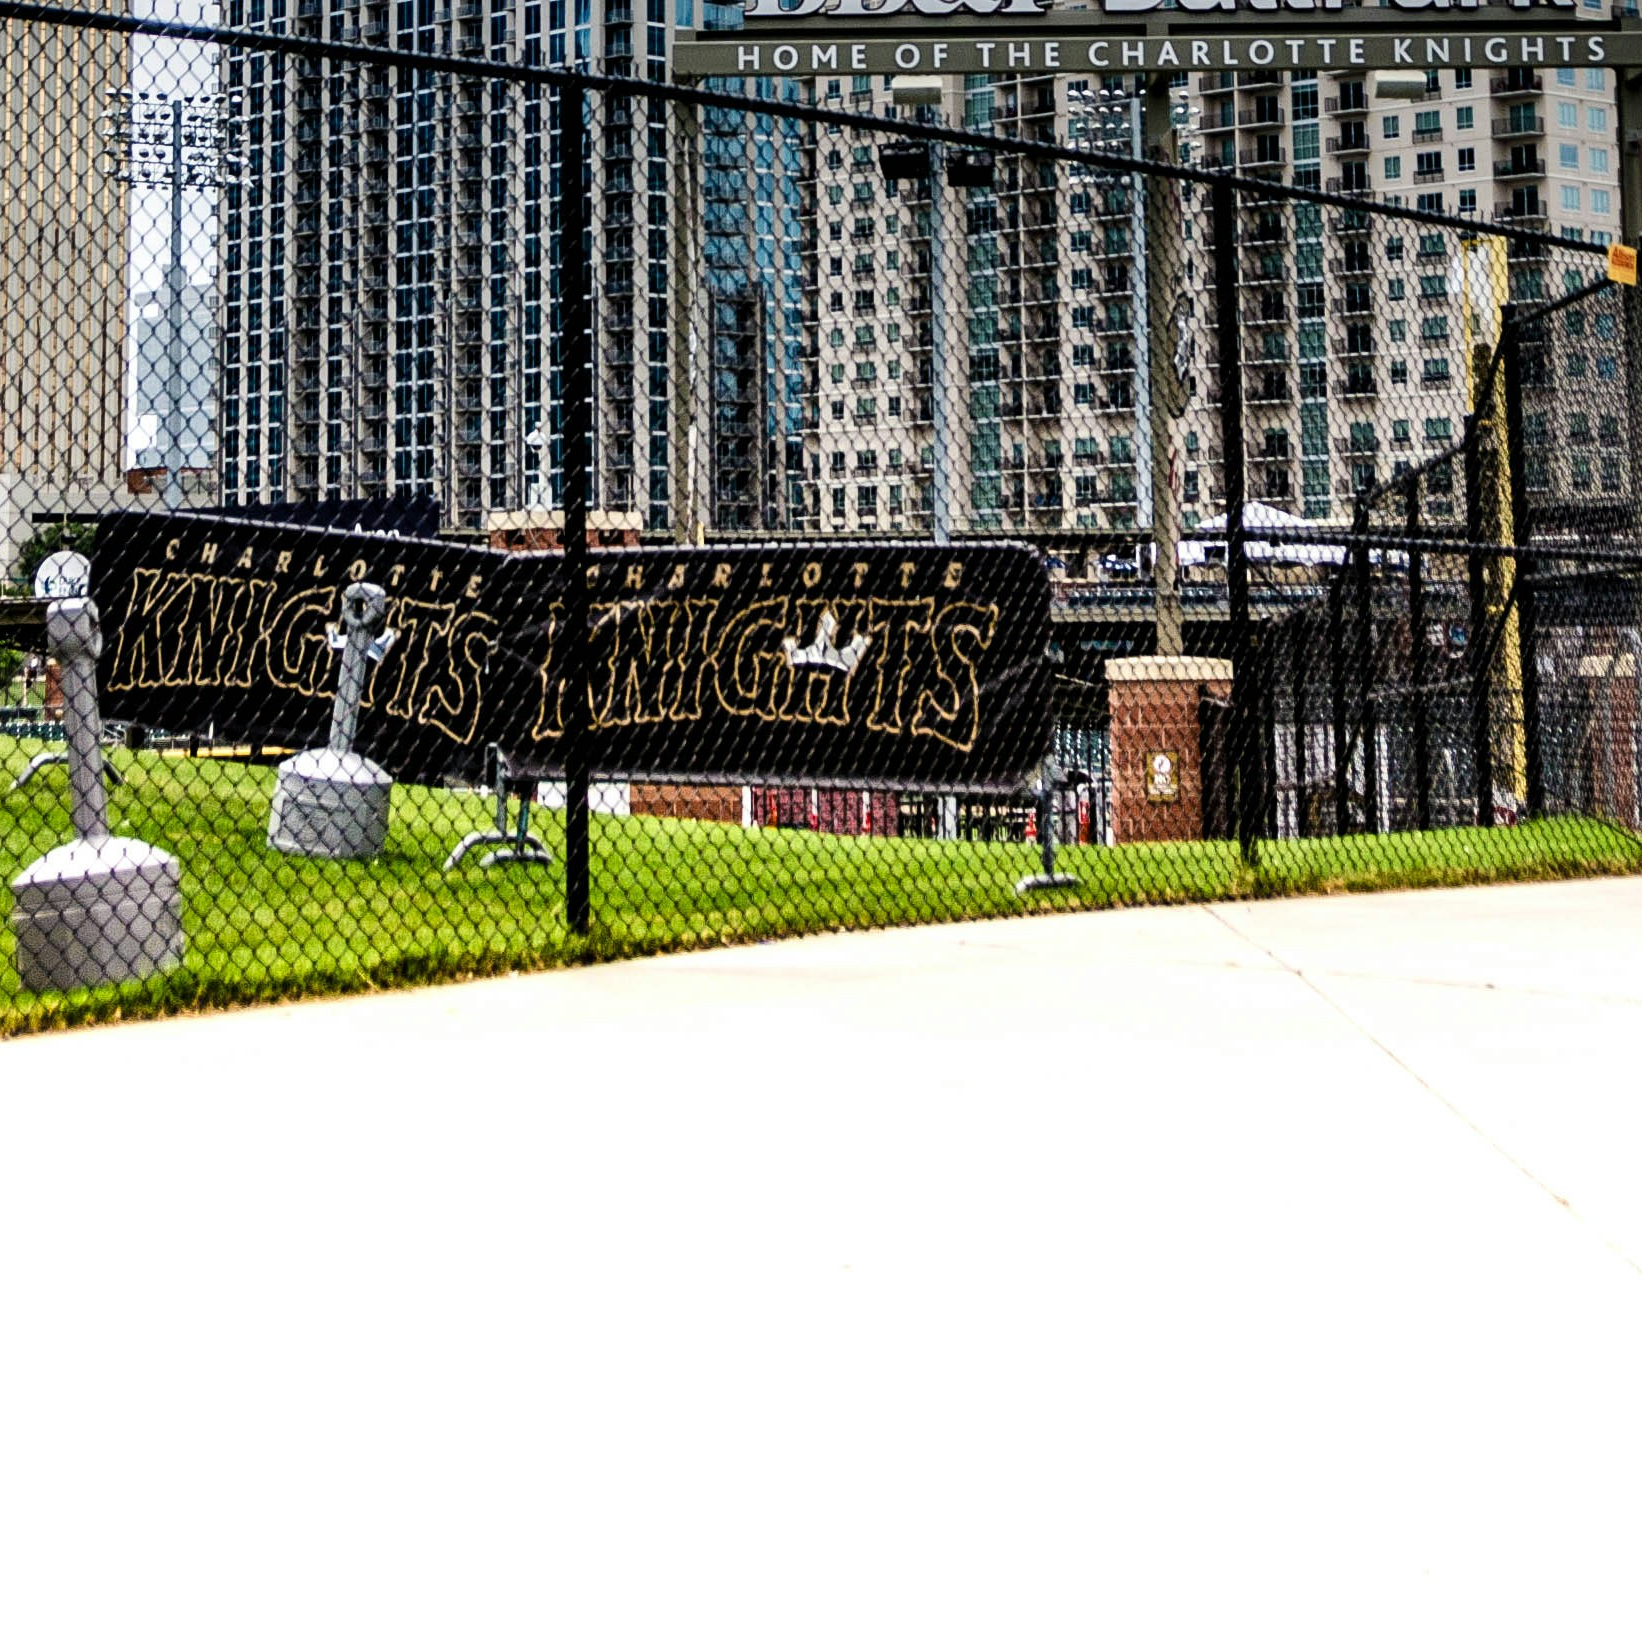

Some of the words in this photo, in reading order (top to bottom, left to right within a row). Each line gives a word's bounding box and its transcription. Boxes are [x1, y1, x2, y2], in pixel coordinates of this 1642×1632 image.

[738, 43, 867, 70] HOME
[894, 42, 949, 69] OF
[976, 41, 1061, 68] THE
[1087, 39, 1366, 67] CHARLOTTE
[1393, 35, 1606, 64] KNIGHTS
[165, 538, 483, 598] CHARLOTTE
